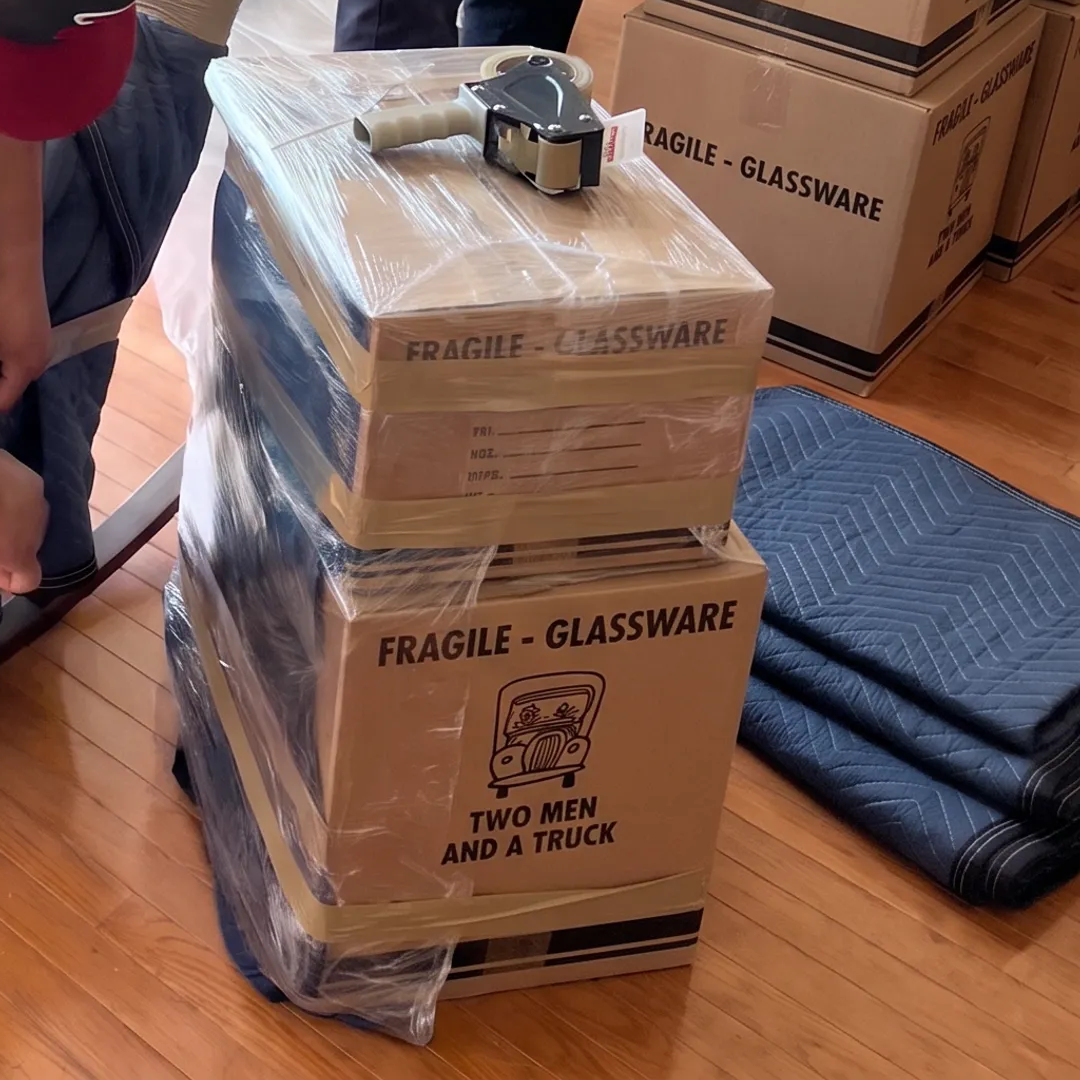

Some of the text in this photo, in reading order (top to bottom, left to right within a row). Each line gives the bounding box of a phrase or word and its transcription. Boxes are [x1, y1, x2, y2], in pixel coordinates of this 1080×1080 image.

[644, 121, 718, 168] RAGILE
[740, 155, 884, 222] GLASSWARE
[406, 333, 525, 361] FRAGILE
[378, 624, 512, 666] FRAGILE
[545, 600, 738, 650] GLASSWARE
[469, 796, 598, 833] TWO MEN
[441, 821, 618, 865] AND A TRUCK
